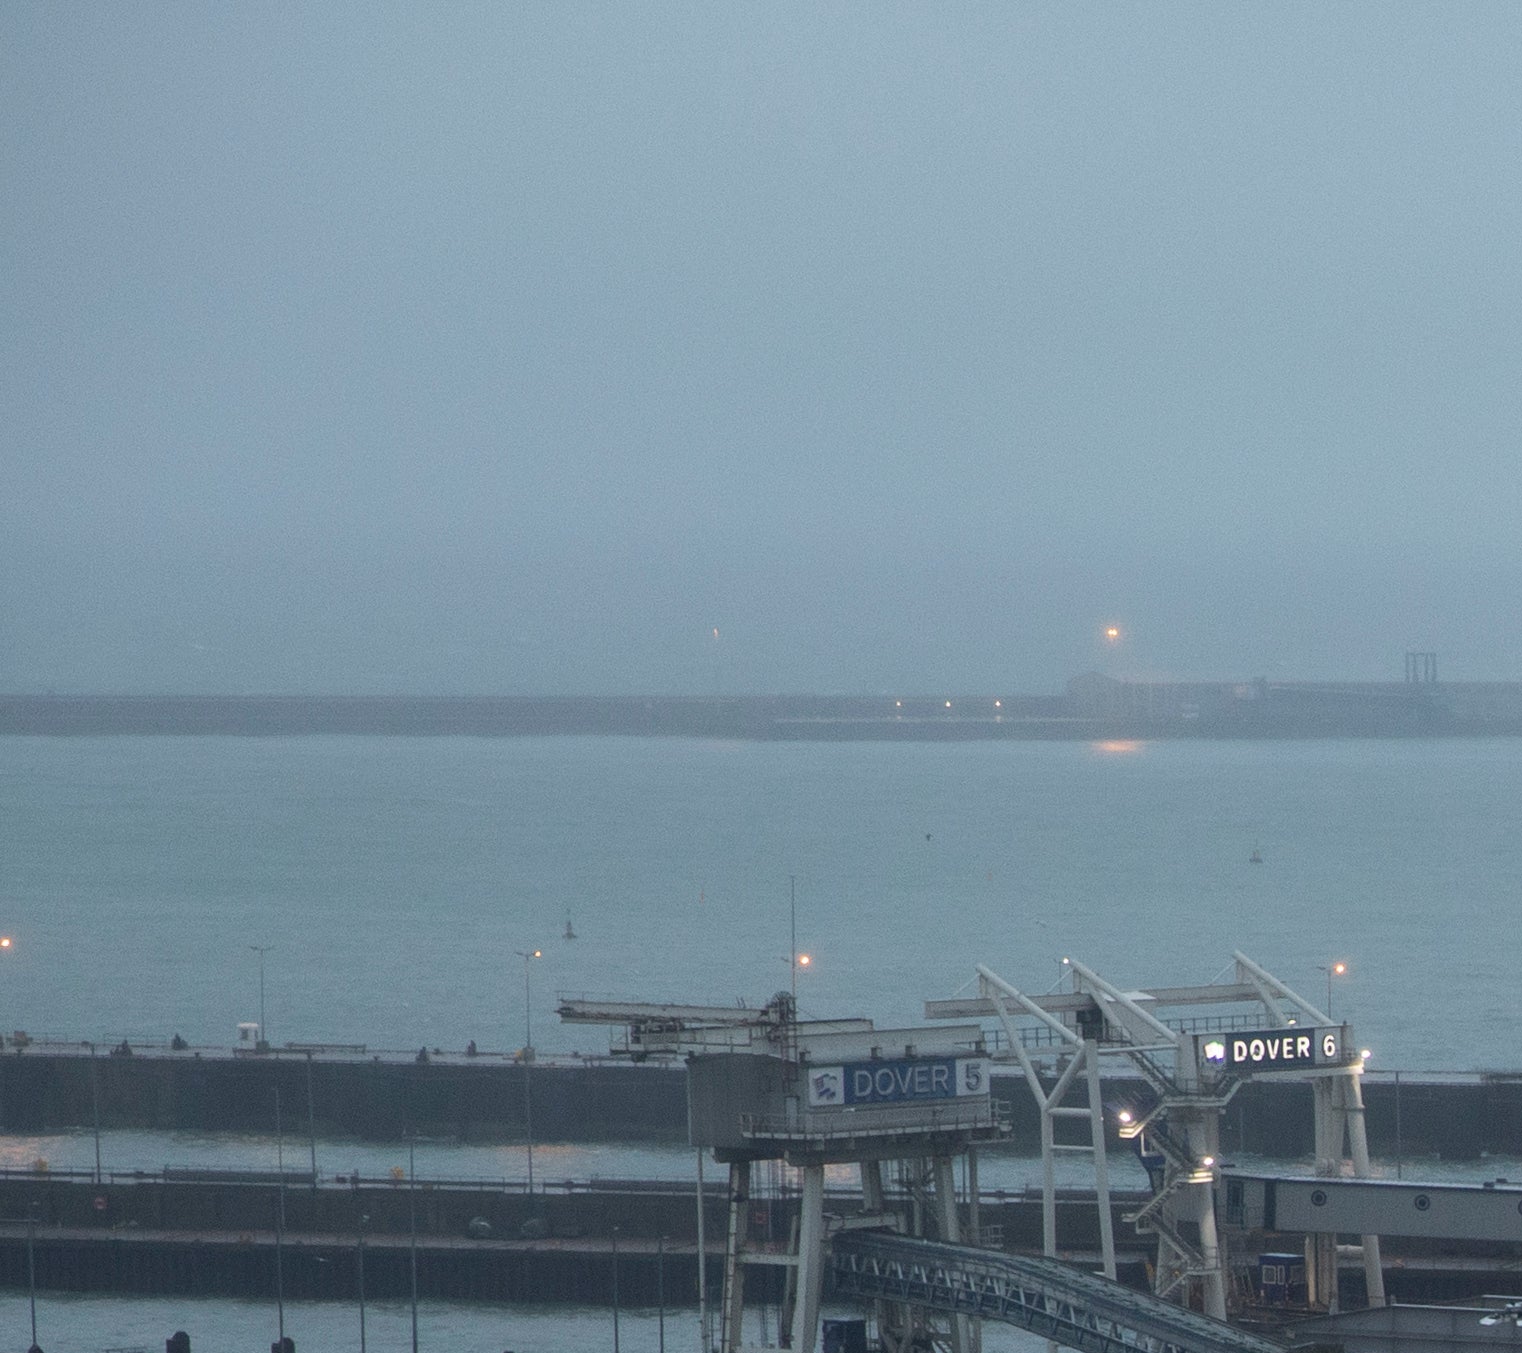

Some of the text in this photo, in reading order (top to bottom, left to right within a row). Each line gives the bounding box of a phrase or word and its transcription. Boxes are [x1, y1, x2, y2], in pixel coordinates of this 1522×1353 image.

[1233, 1034, 1337, 1062] DOVER 6
[853, 1063, 983, 1098] DOVER 5
